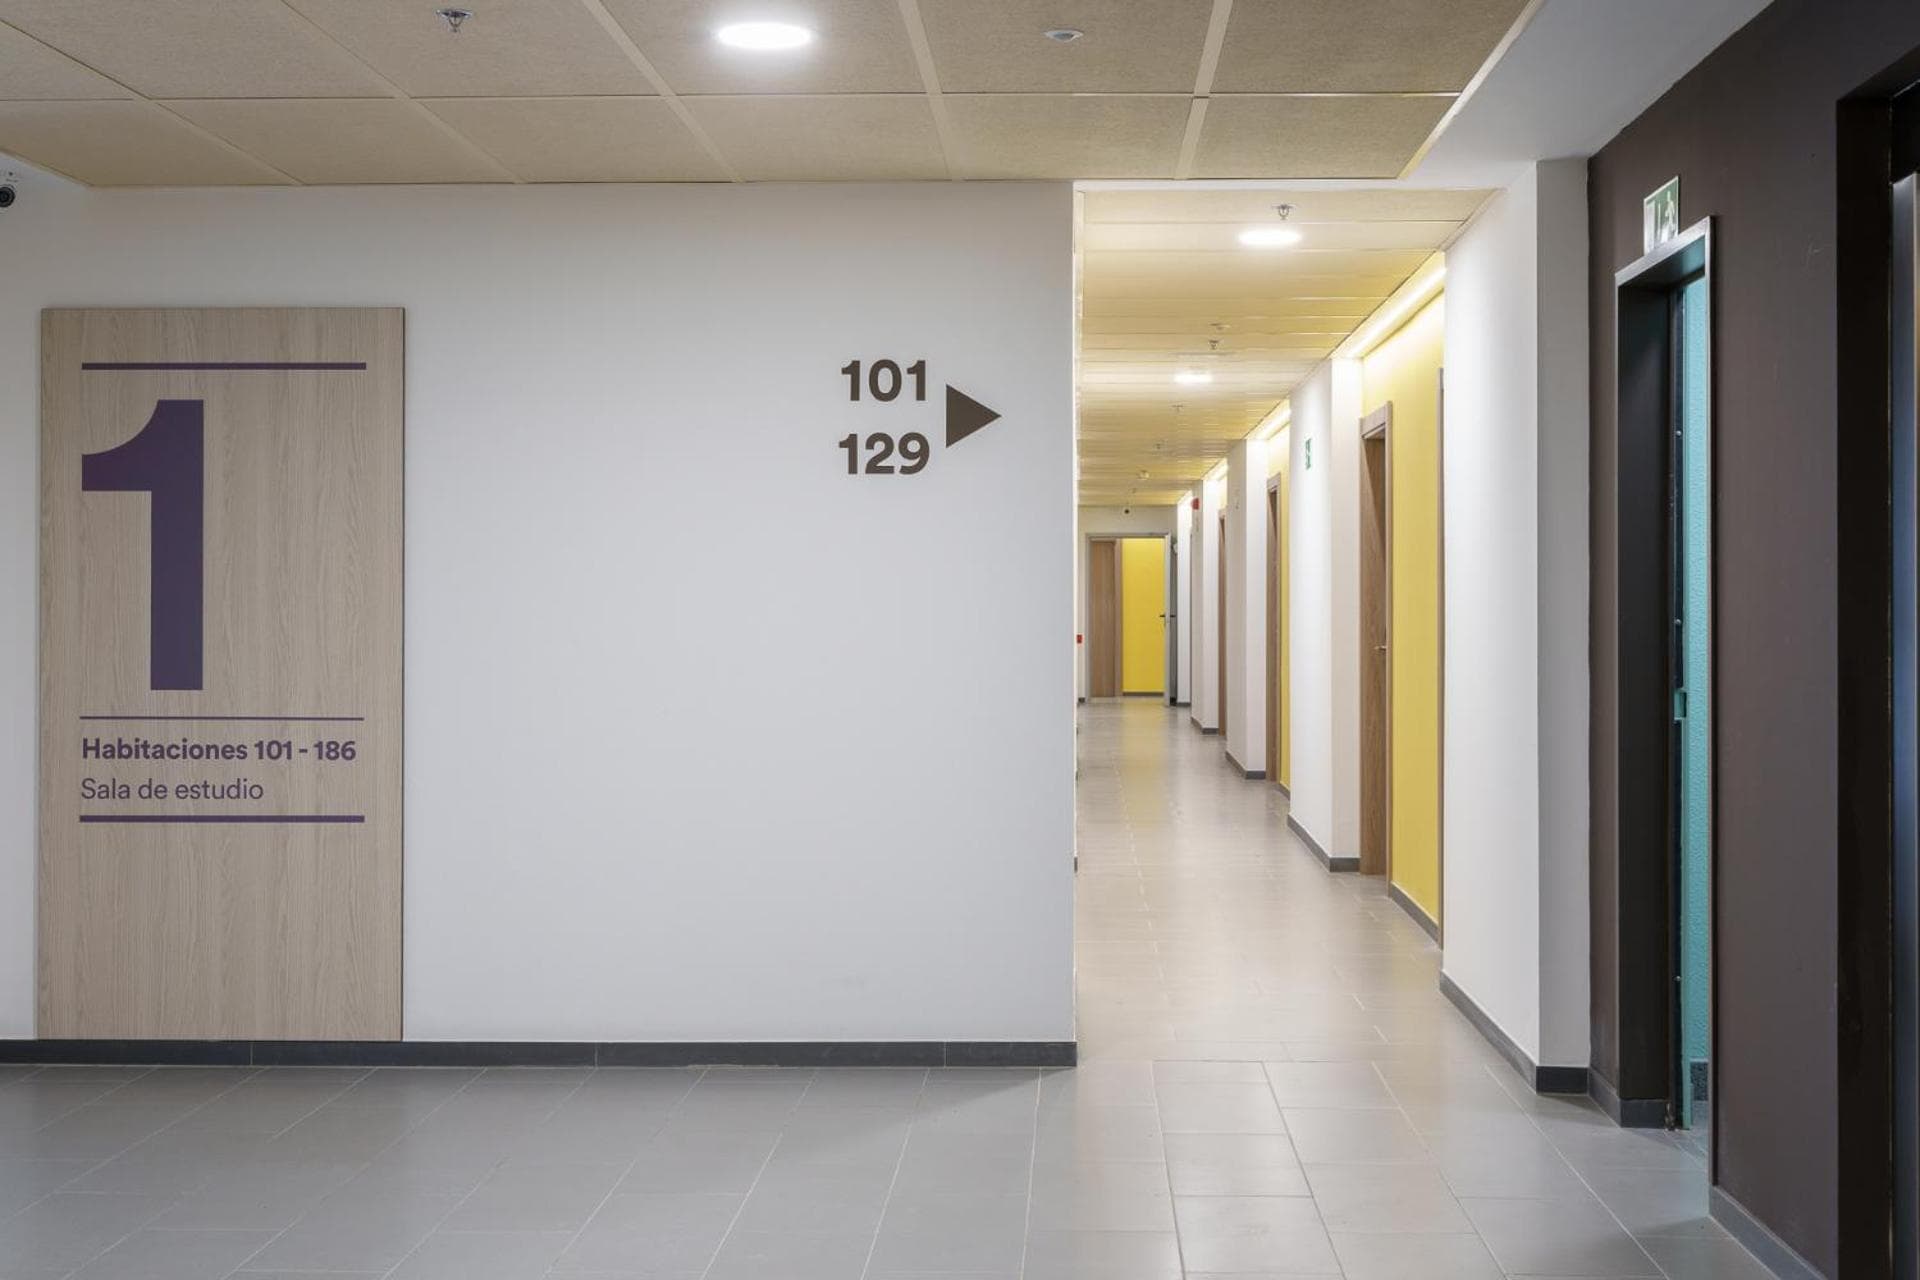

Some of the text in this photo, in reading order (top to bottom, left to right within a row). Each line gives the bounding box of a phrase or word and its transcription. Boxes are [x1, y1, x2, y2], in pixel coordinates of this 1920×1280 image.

[841, 358, 926, 402] 101
[838, 432, 930, 475] 129
[81, 399, 204, 690] 1
[81, 737, 248, 761] Habitaciones
[254, 740, 293, 761] 101
[314, 740, 357, 761] 186
[80, 777, 265, 801] Sala de estudio
